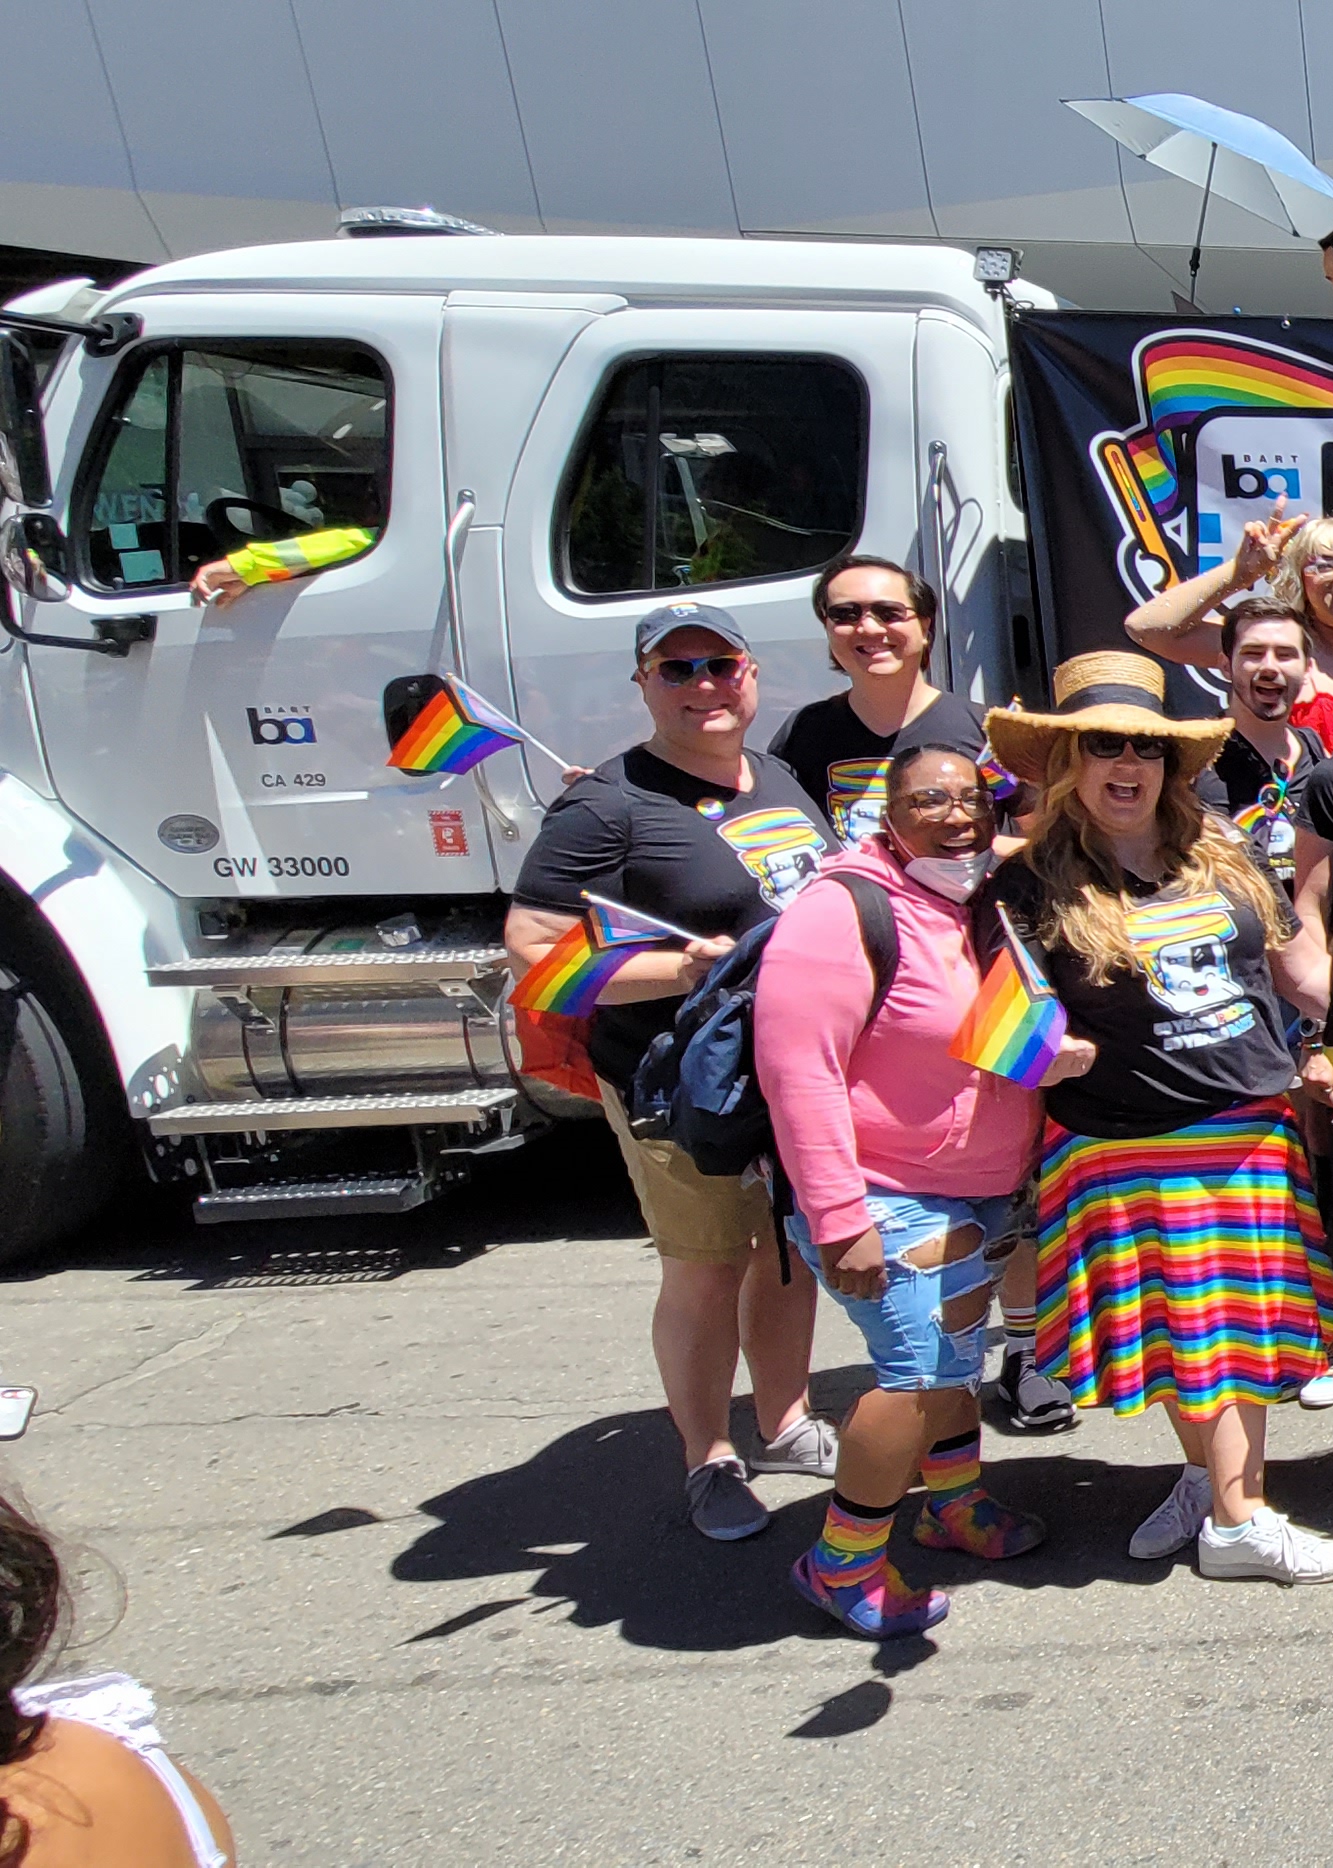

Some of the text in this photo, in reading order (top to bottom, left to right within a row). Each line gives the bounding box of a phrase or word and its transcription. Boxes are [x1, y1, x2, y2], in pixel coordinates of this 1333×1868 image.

[1243, 454, 1299, 463] BART
[261, 773, 327, 788] CA 429
[213, 856, 350, 878] GW 33000
